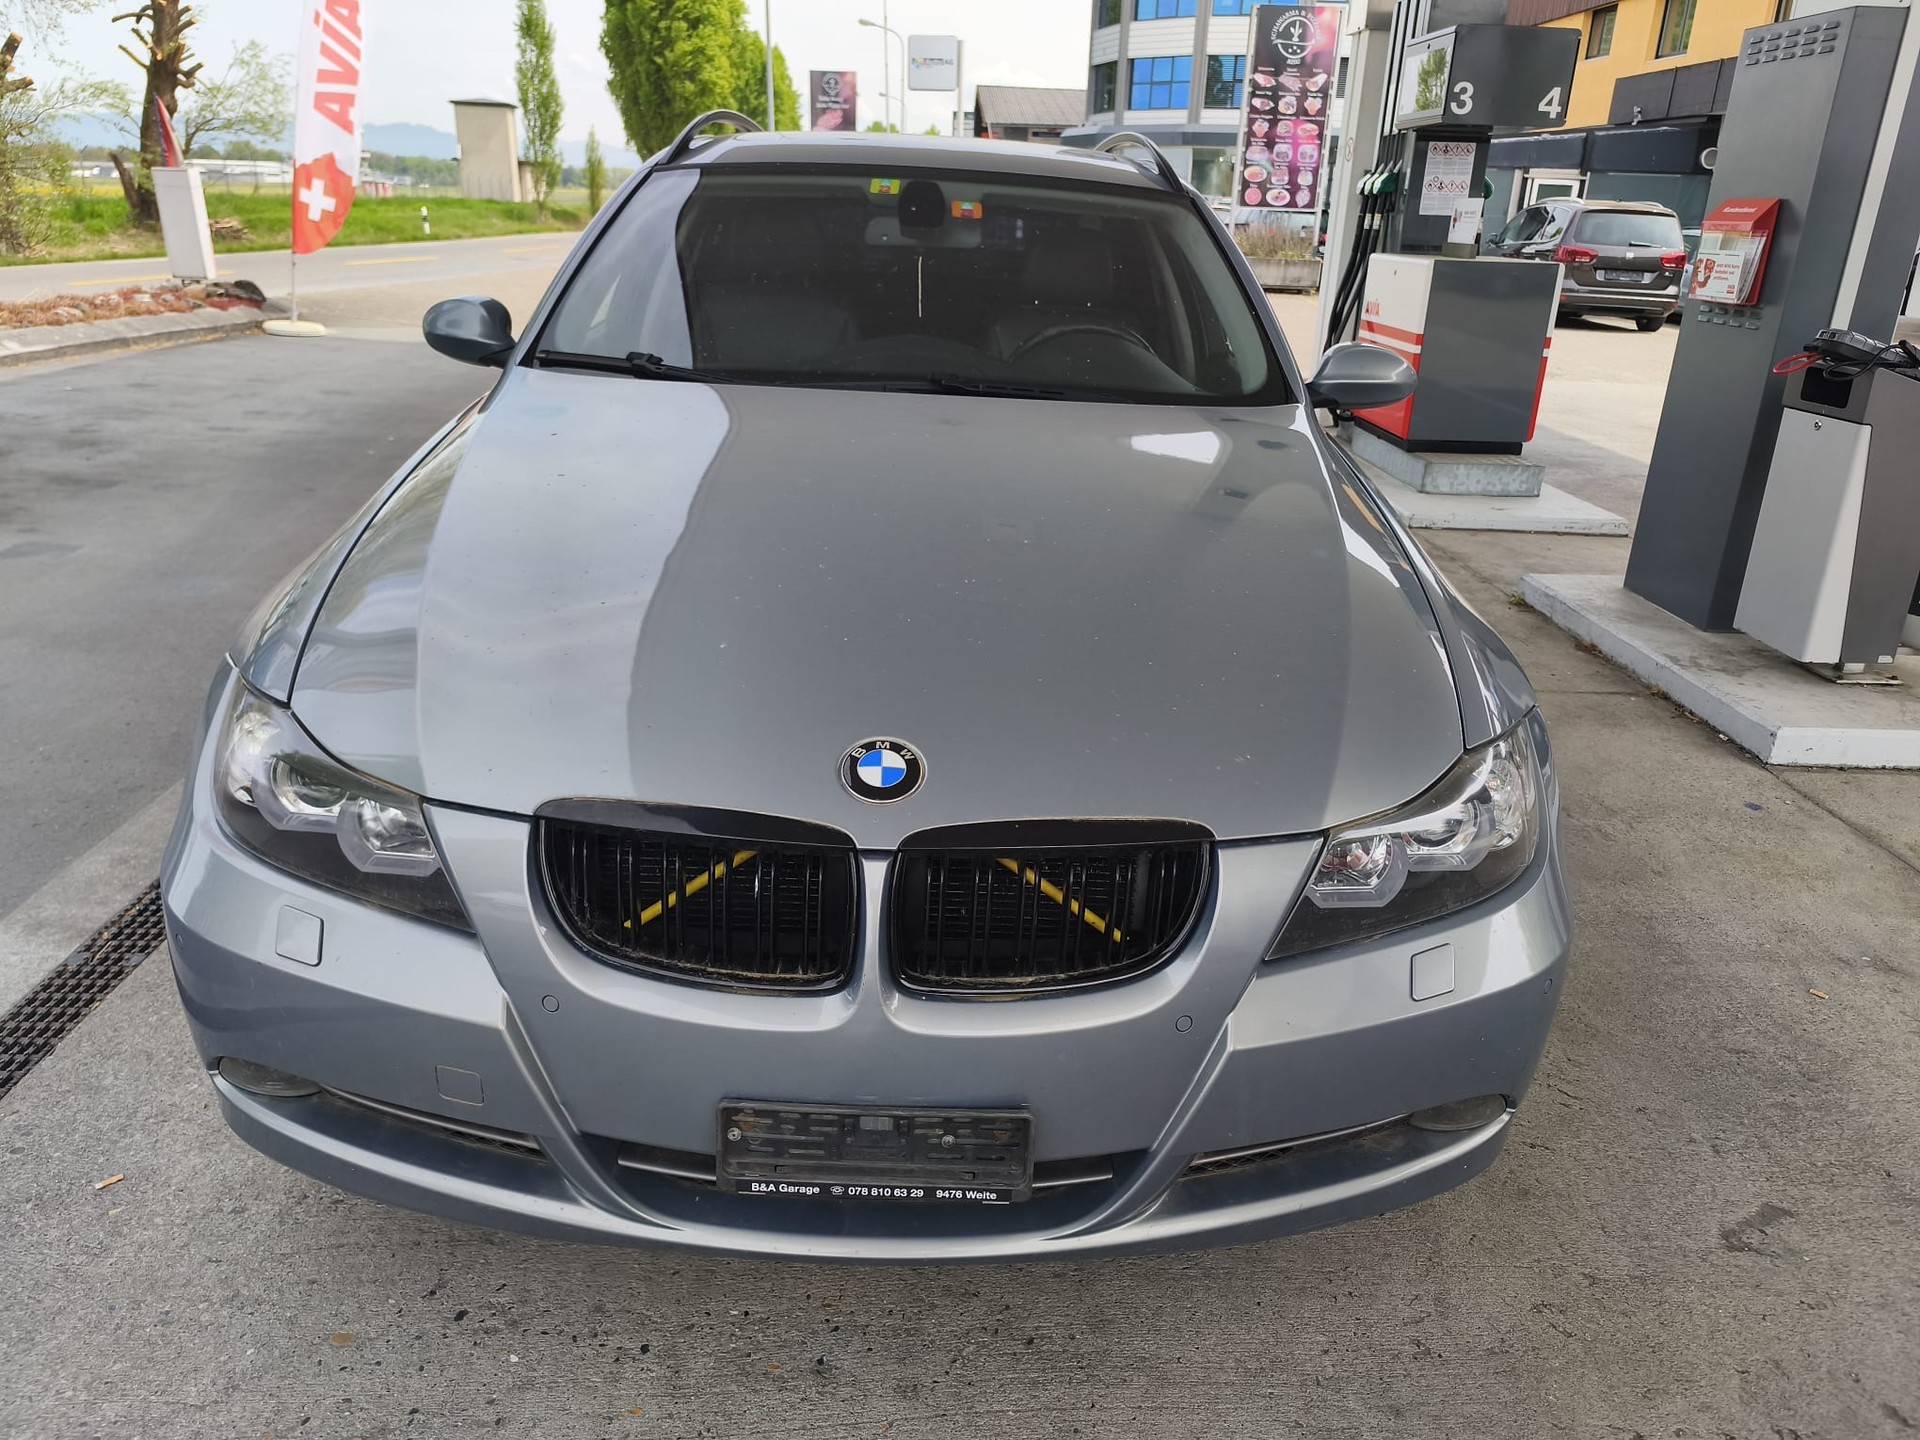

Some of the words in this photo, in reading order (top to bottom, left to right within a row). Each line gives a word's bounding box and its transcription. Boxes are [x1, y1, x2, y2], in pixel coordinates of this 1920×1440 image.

[1450, 81, 1474, 115] 3
[1538, 86, 1562, 119] 4
[851, 741, 915, 760] BMW
[751, 1182, 776, 1192] B&A
[779, 1183, 820, 1195] Garage
[848, 1186, 868, 1196] 078
[871, 1187, 892, 1197] 810
[893, 1188, 908, 1197] 63
[910, 1188, 924, 1198] 29
[936, 1189, 963, 1199] 9476
